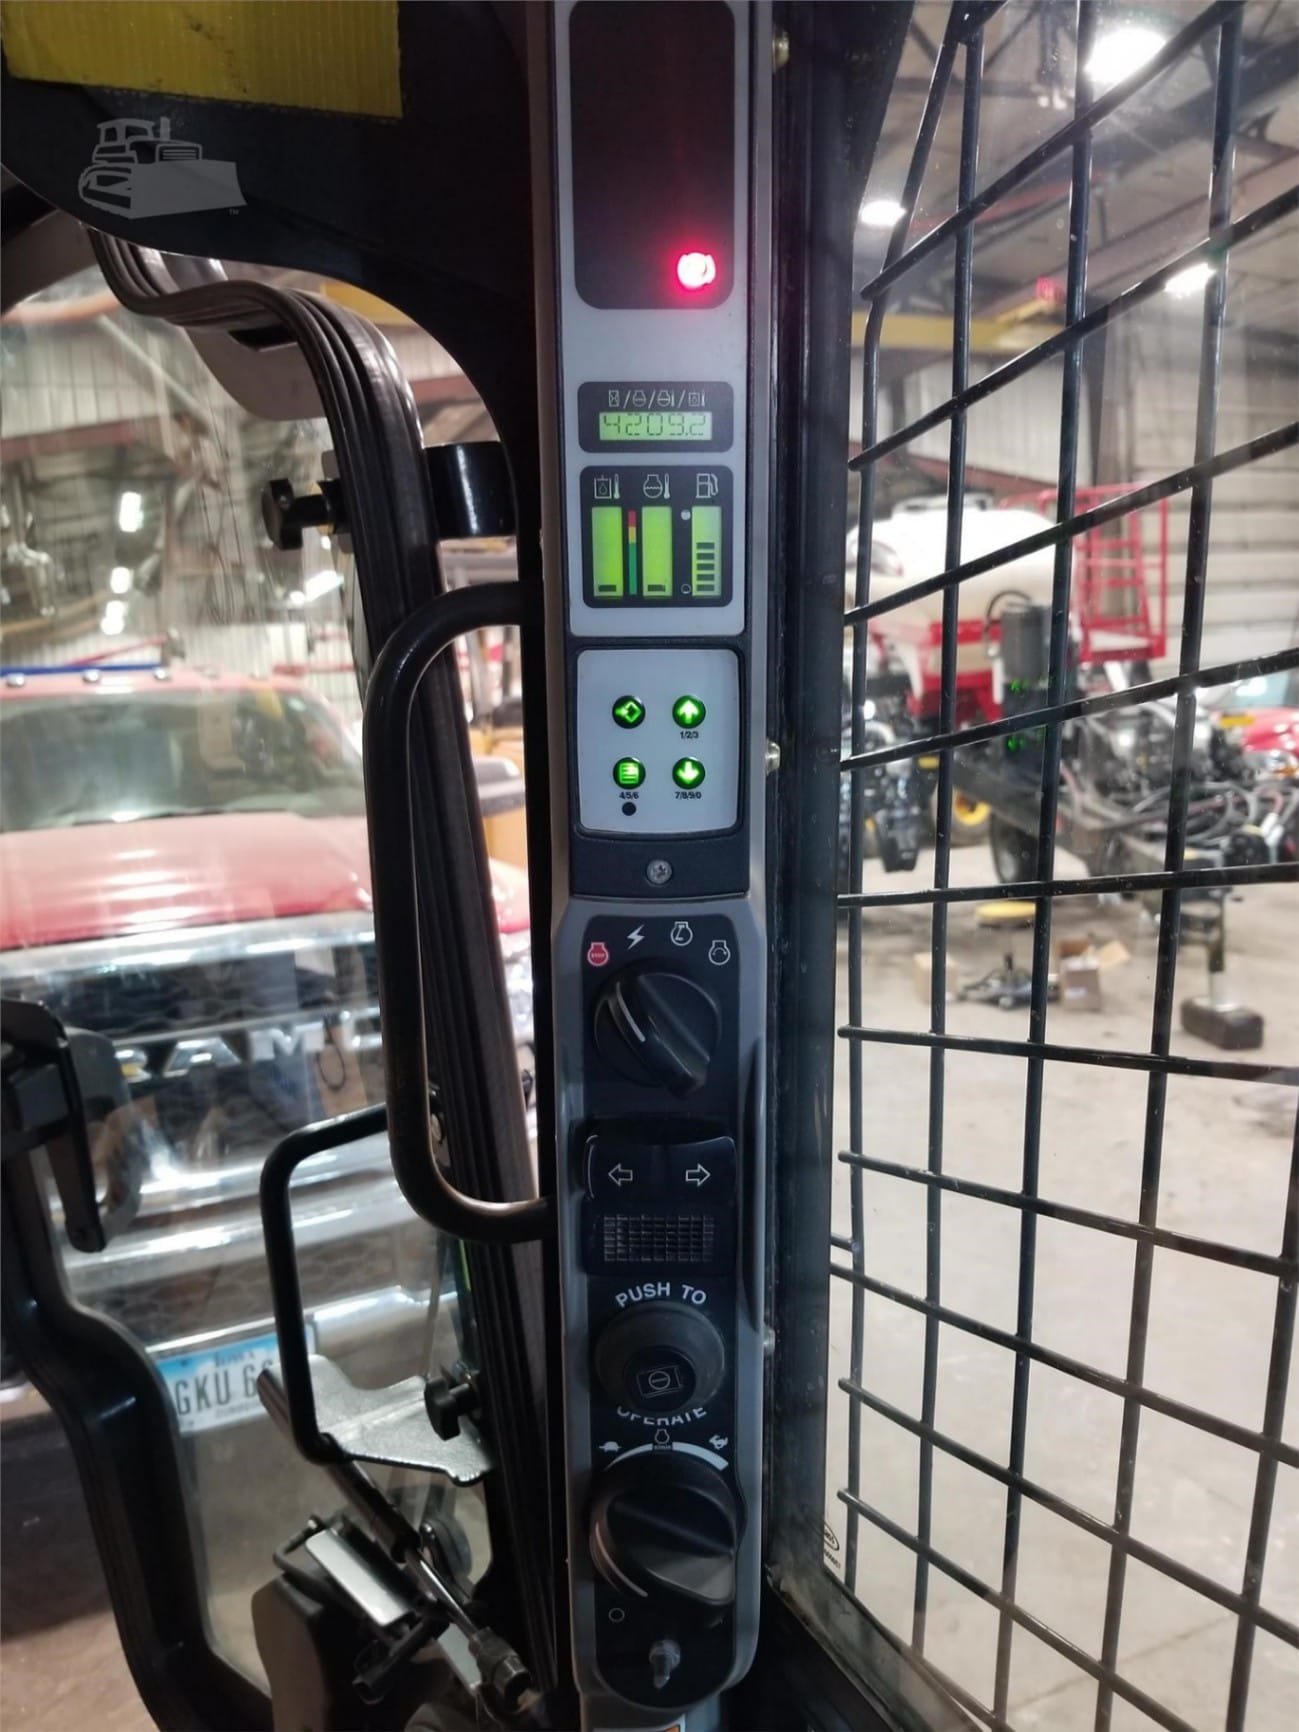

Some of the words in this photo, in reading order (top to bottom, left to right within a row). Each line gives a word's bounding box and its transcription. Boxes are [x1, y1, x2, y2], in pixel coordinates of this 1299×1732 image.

[680, 731, 699, 739] 1/2/3
[619, 791, 639, 799] 4/5/6
[675, 791, 702, 799] 7/8/9/0
[615, 1282, 671, 1308] PUSH
[681, 1284, 707, 1305] TO
[174, 1370, 231, 1416] GKU
